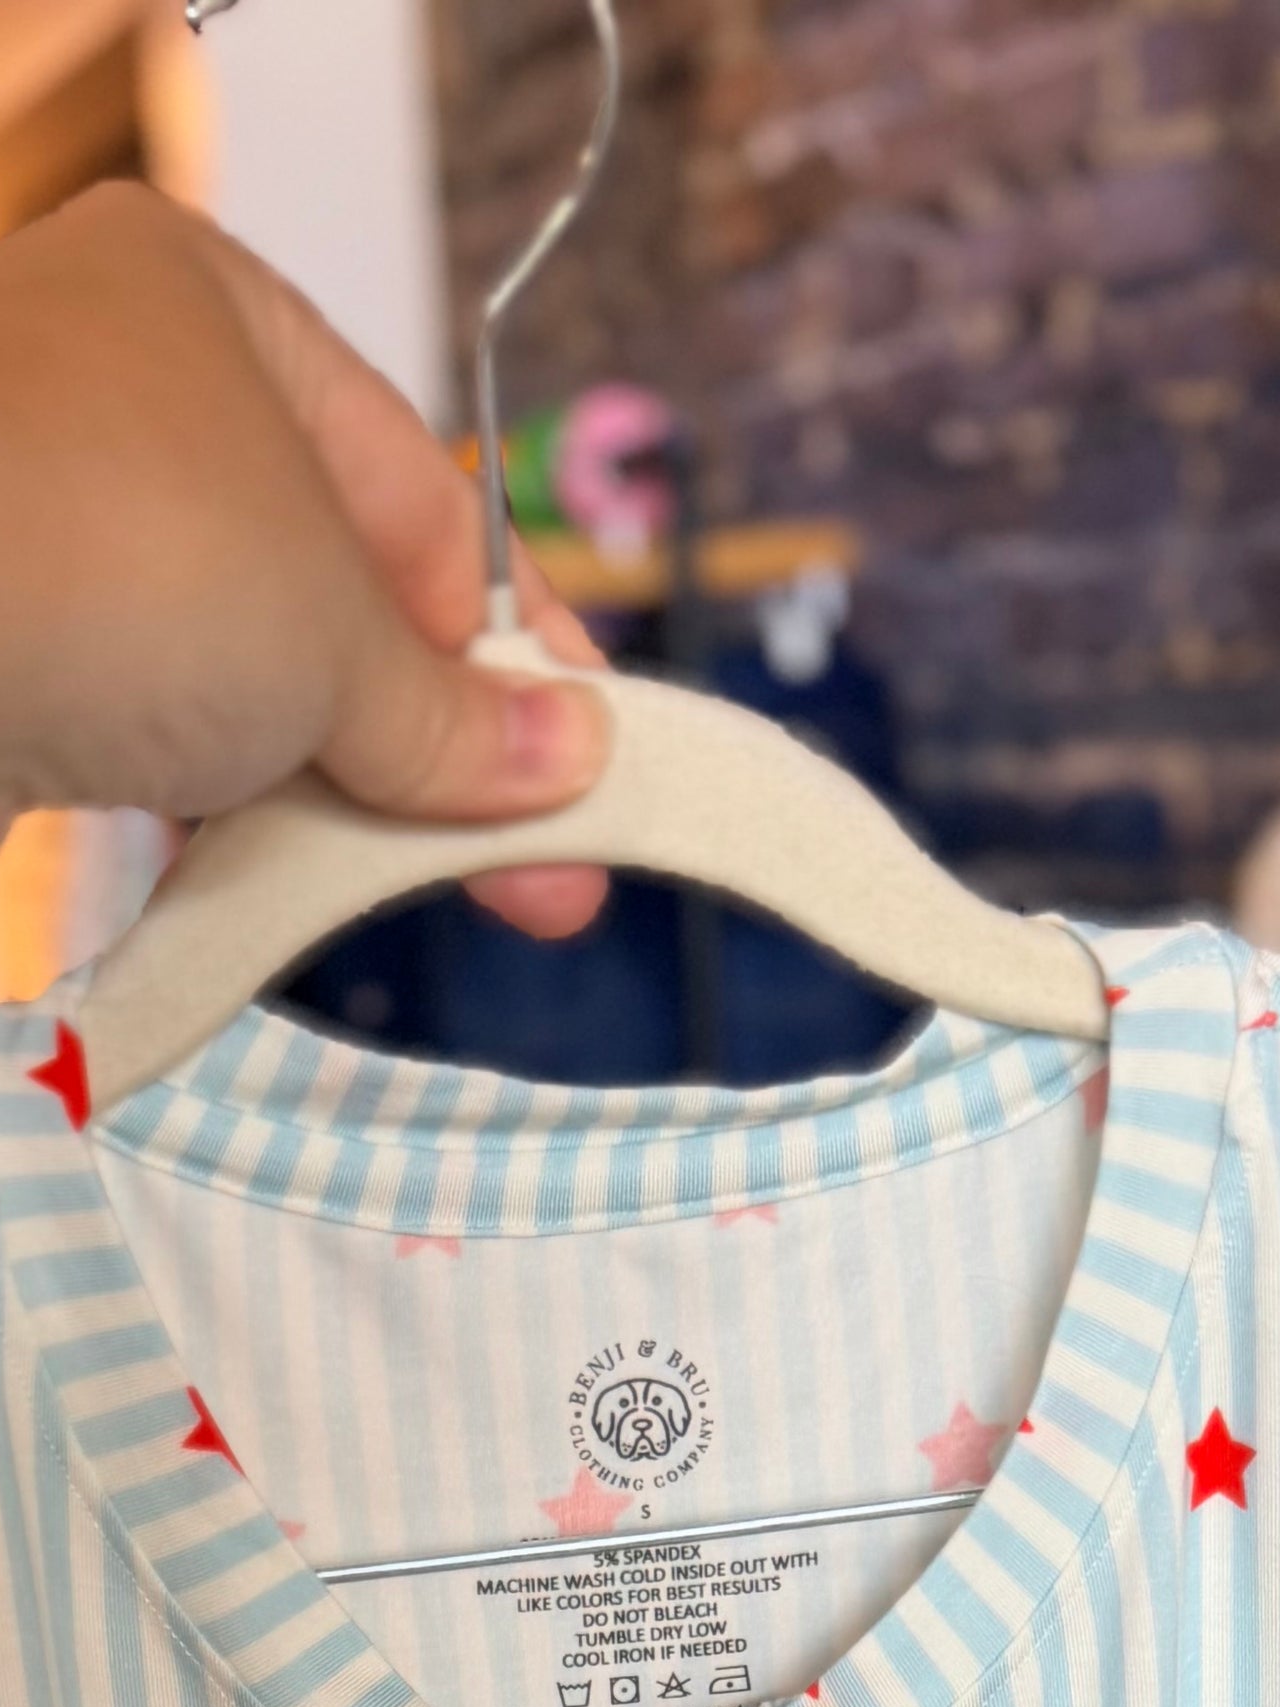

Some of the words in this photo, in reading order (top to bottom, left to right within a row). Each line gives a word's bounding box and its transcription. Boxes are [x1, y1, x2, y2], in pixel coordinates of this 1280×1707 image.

[569, 1343, 624, 1406] BENJI
[638, 1339, 657, 1357] &
[666, 1348, 710, 1396] BRU
[570, 1425, 644, 1491] CLOTHING
[654, 1417, 714, 1488] COMPANY
[640, 1504, 651, 1519] S
[593, 1550, 619, 1568] 5%
[623, 1545, 701, 1565] SPANDEX
[476, 1576, 559, 1595] MACHINE
[564, 1572, 615, 1589] WASH
[620, 1568, 666, 1585] COLD
[671, 1562, 726, 1580] INSIDE
[730, 1557, 767, 1574] OUT
[771, 1551, 818, 1571] WITH
[517, 1596, 551, 1612] LIKE
[556, 1591, 623, 1610] COLORS
[628, 1588, 661, 1603] FOR
[666, 1583, 706, 1600] BEST
[711, 1576, 781, 1596] RESULTS
[583, 1612, 608, 1627] DO
[613, 1608, 649, 1625] NOT
[654, 1602, 718, 1621] BLEACH
[575, 1628, 645, 1647] TUMBLE
[650, 1625, 683, 1642] DRY
[688, 1620, 727, 1638] LOW
[562, 1651, 609, 1668] COOL
[614, 1647, 655, 1664] IRON
[661, 1645, 675, 1660] IF
[680, 1638, 747, 1658] NEEDED
